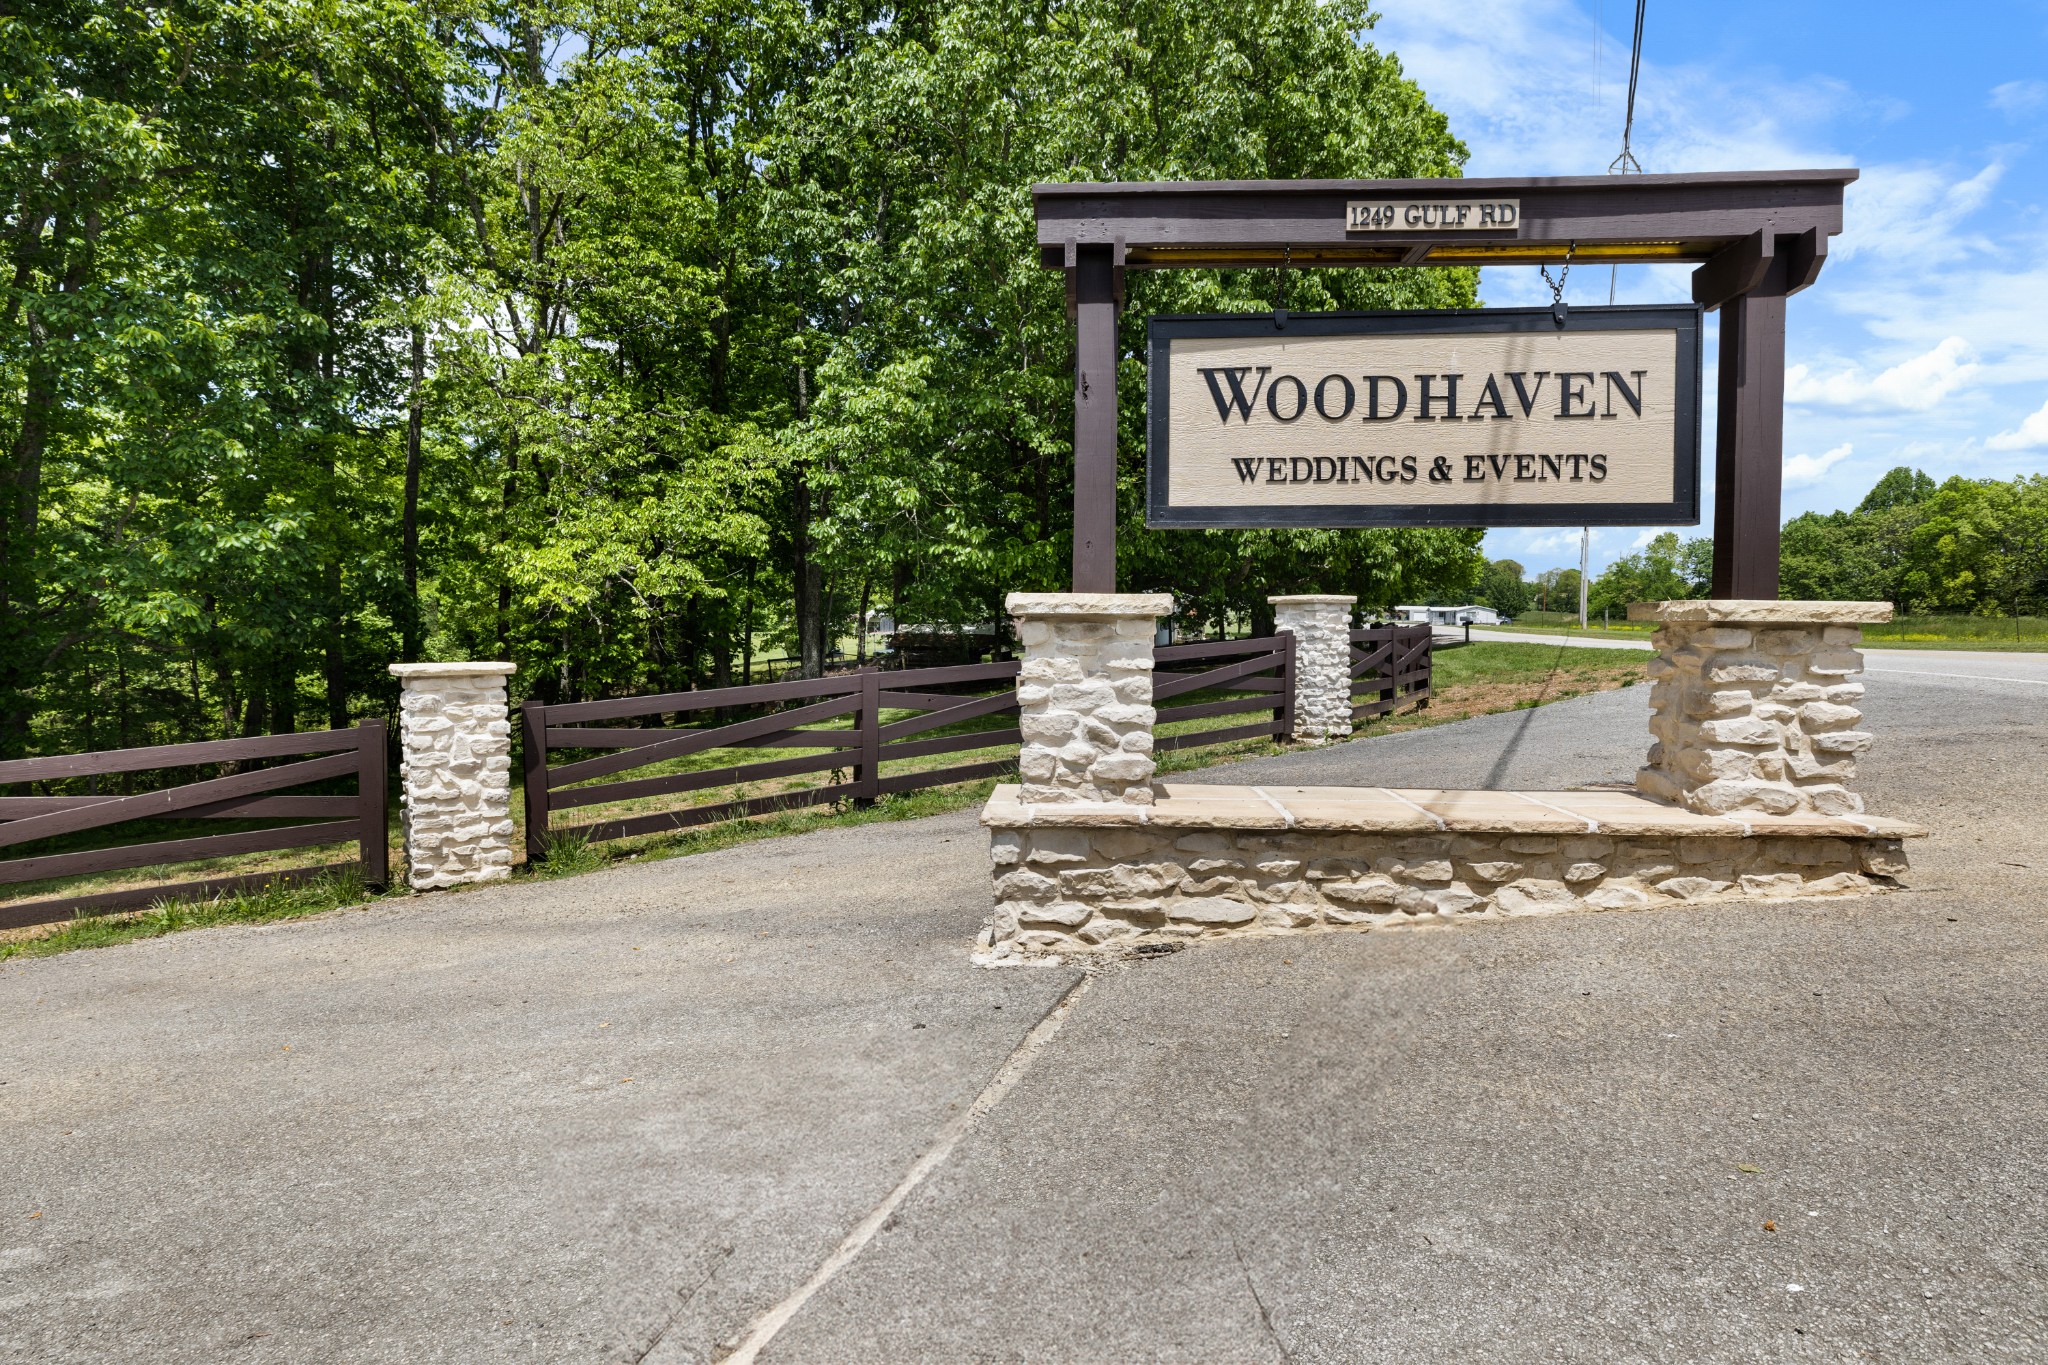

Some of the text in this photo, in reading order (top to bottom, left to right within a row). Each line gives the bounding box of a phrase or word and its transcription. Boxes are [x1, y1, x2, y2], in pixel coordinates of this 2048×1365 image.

[1351, 203, 1517, 226] 1249 GULF RD
[1197, 365, 1648, 424] WOODHAVEN
[1231, 454, 1608, 483] WEDDINGS & EVENTS
